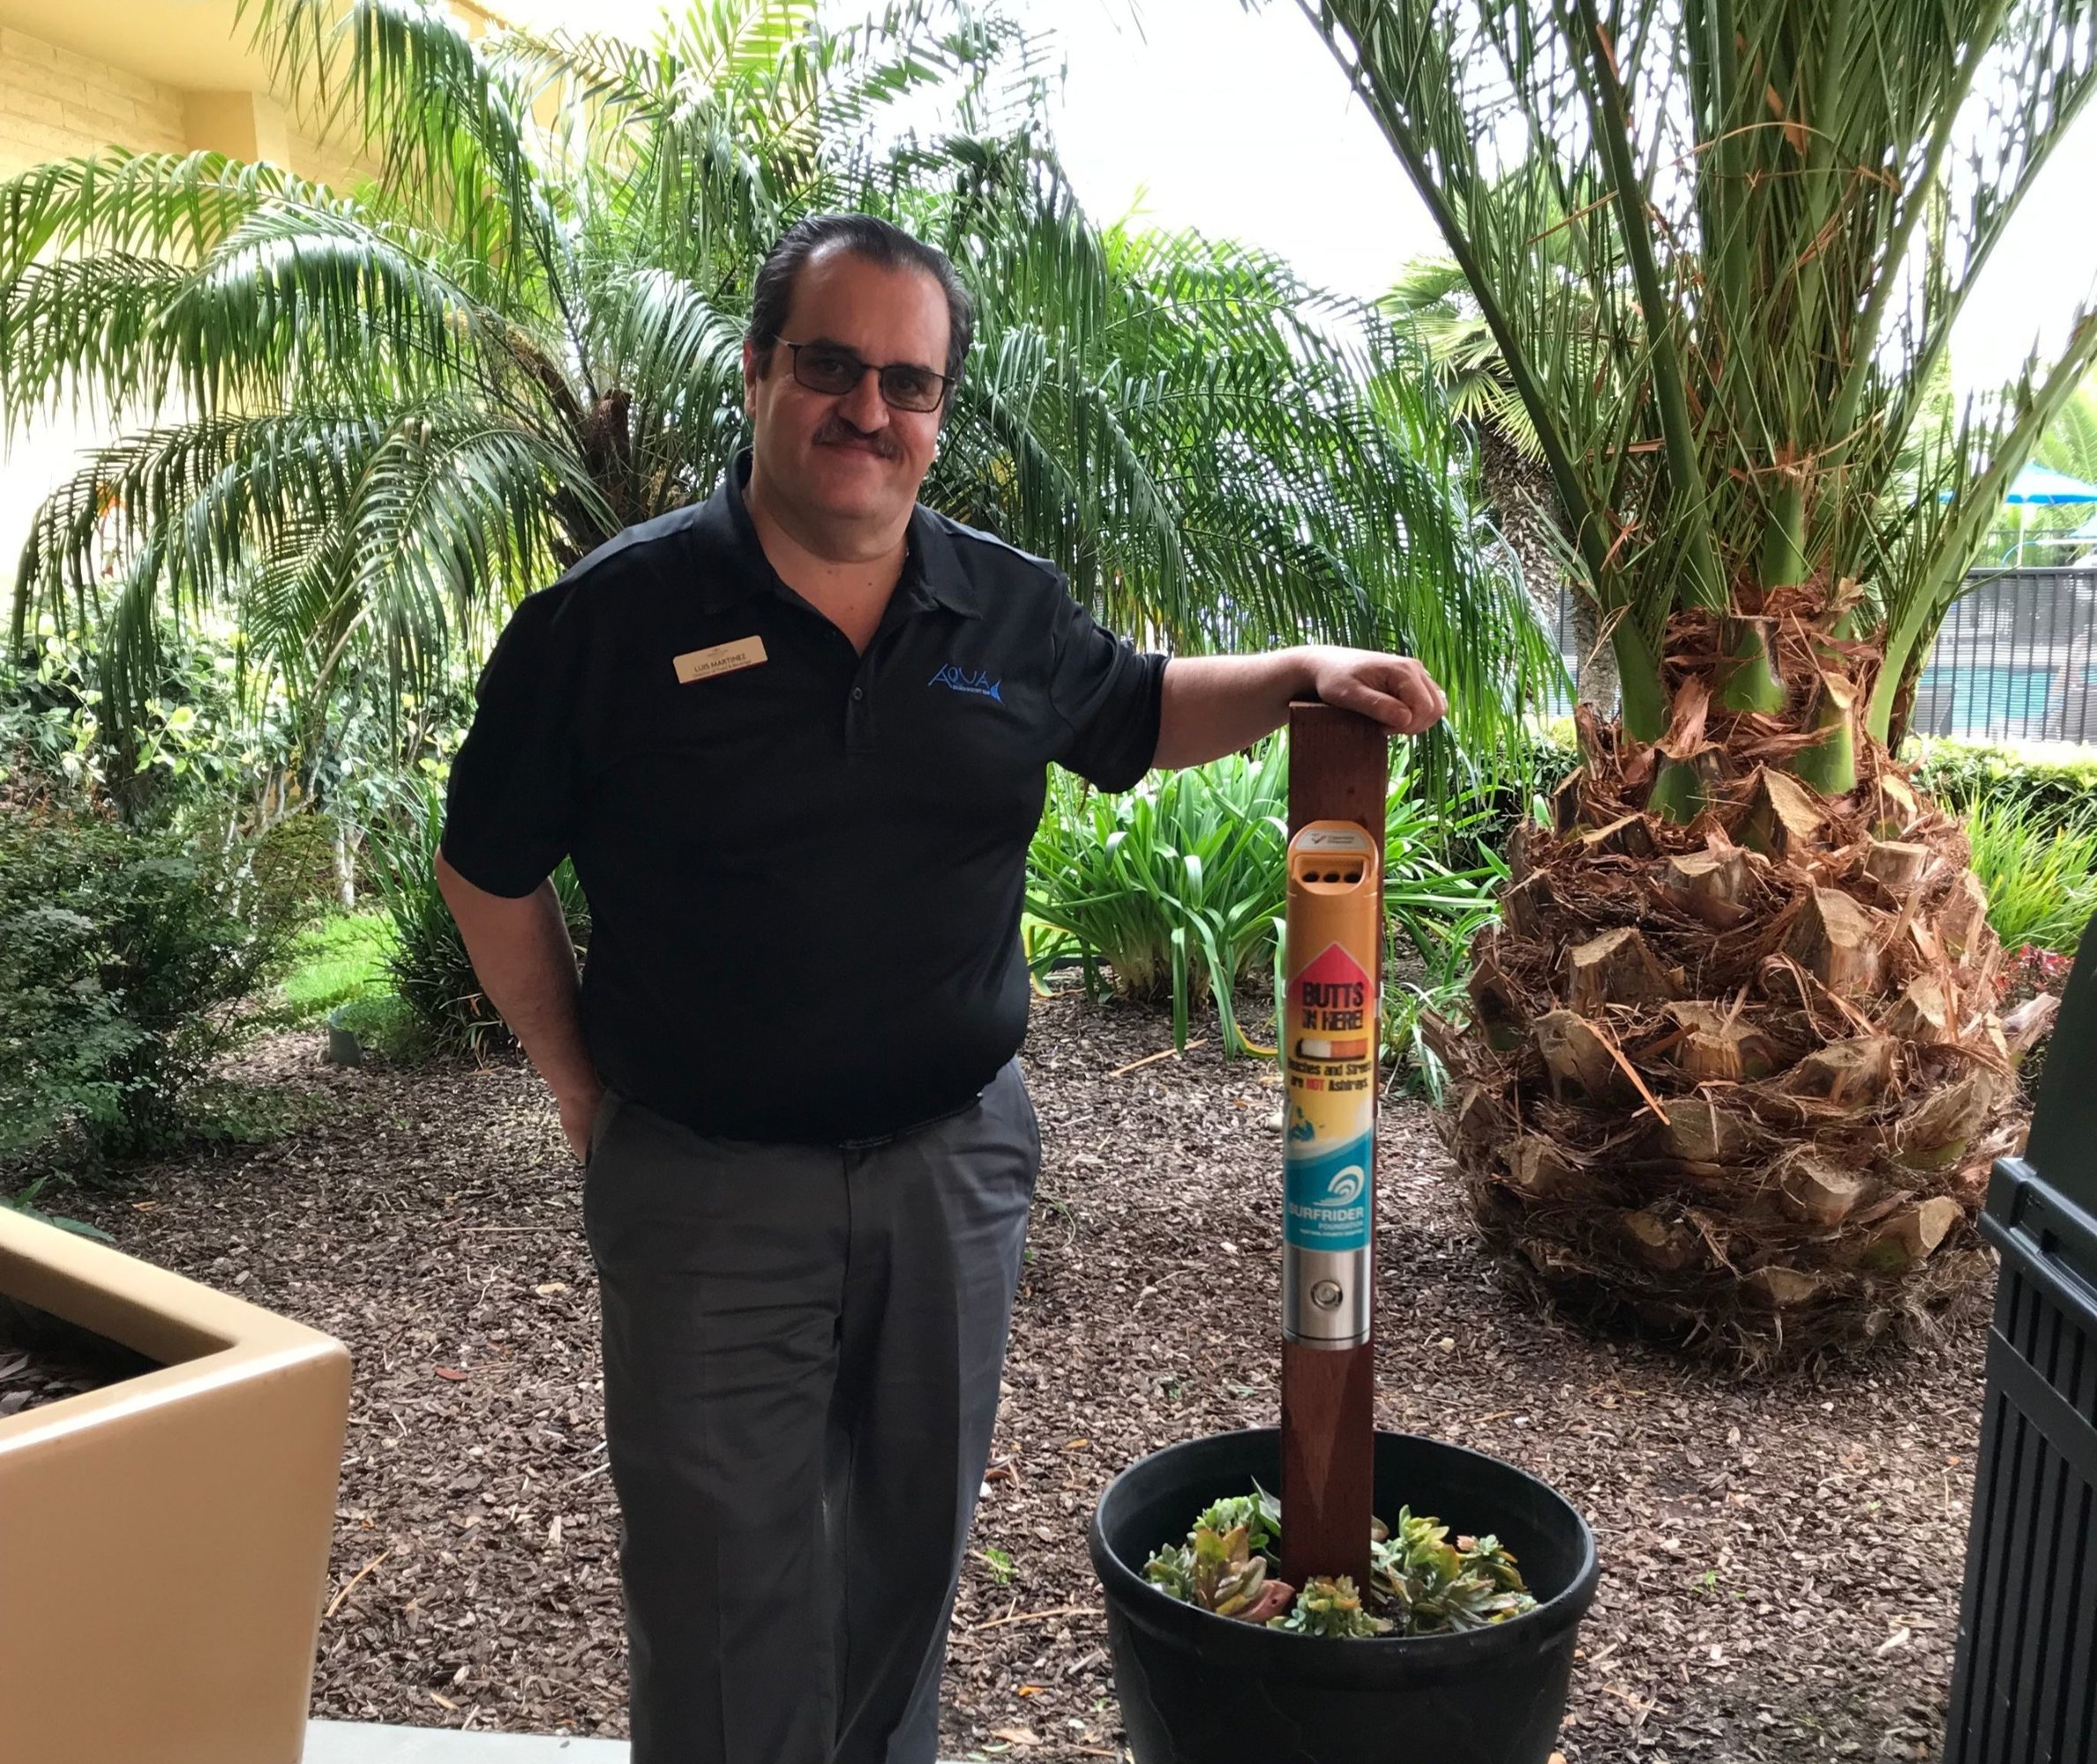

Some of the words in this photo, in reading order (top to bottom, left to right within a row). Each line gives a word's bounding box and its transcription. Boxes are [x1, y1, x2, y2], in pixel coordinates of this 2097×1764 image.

[694, 663, 710, 673] LUIS
[710, 653, 746, 668] MARTINEZ
[927, 663, 990, 689] AQUA
[1302, 981, 1364, 1008] BUTTS
[1302, 1008, 1317, 1031] IN
[1324, 1065, 1343, 1076] and
[1306, 1077, 1325, 1091] NOT
[1288, 1202, 1364, 1222] SURFRIDER
